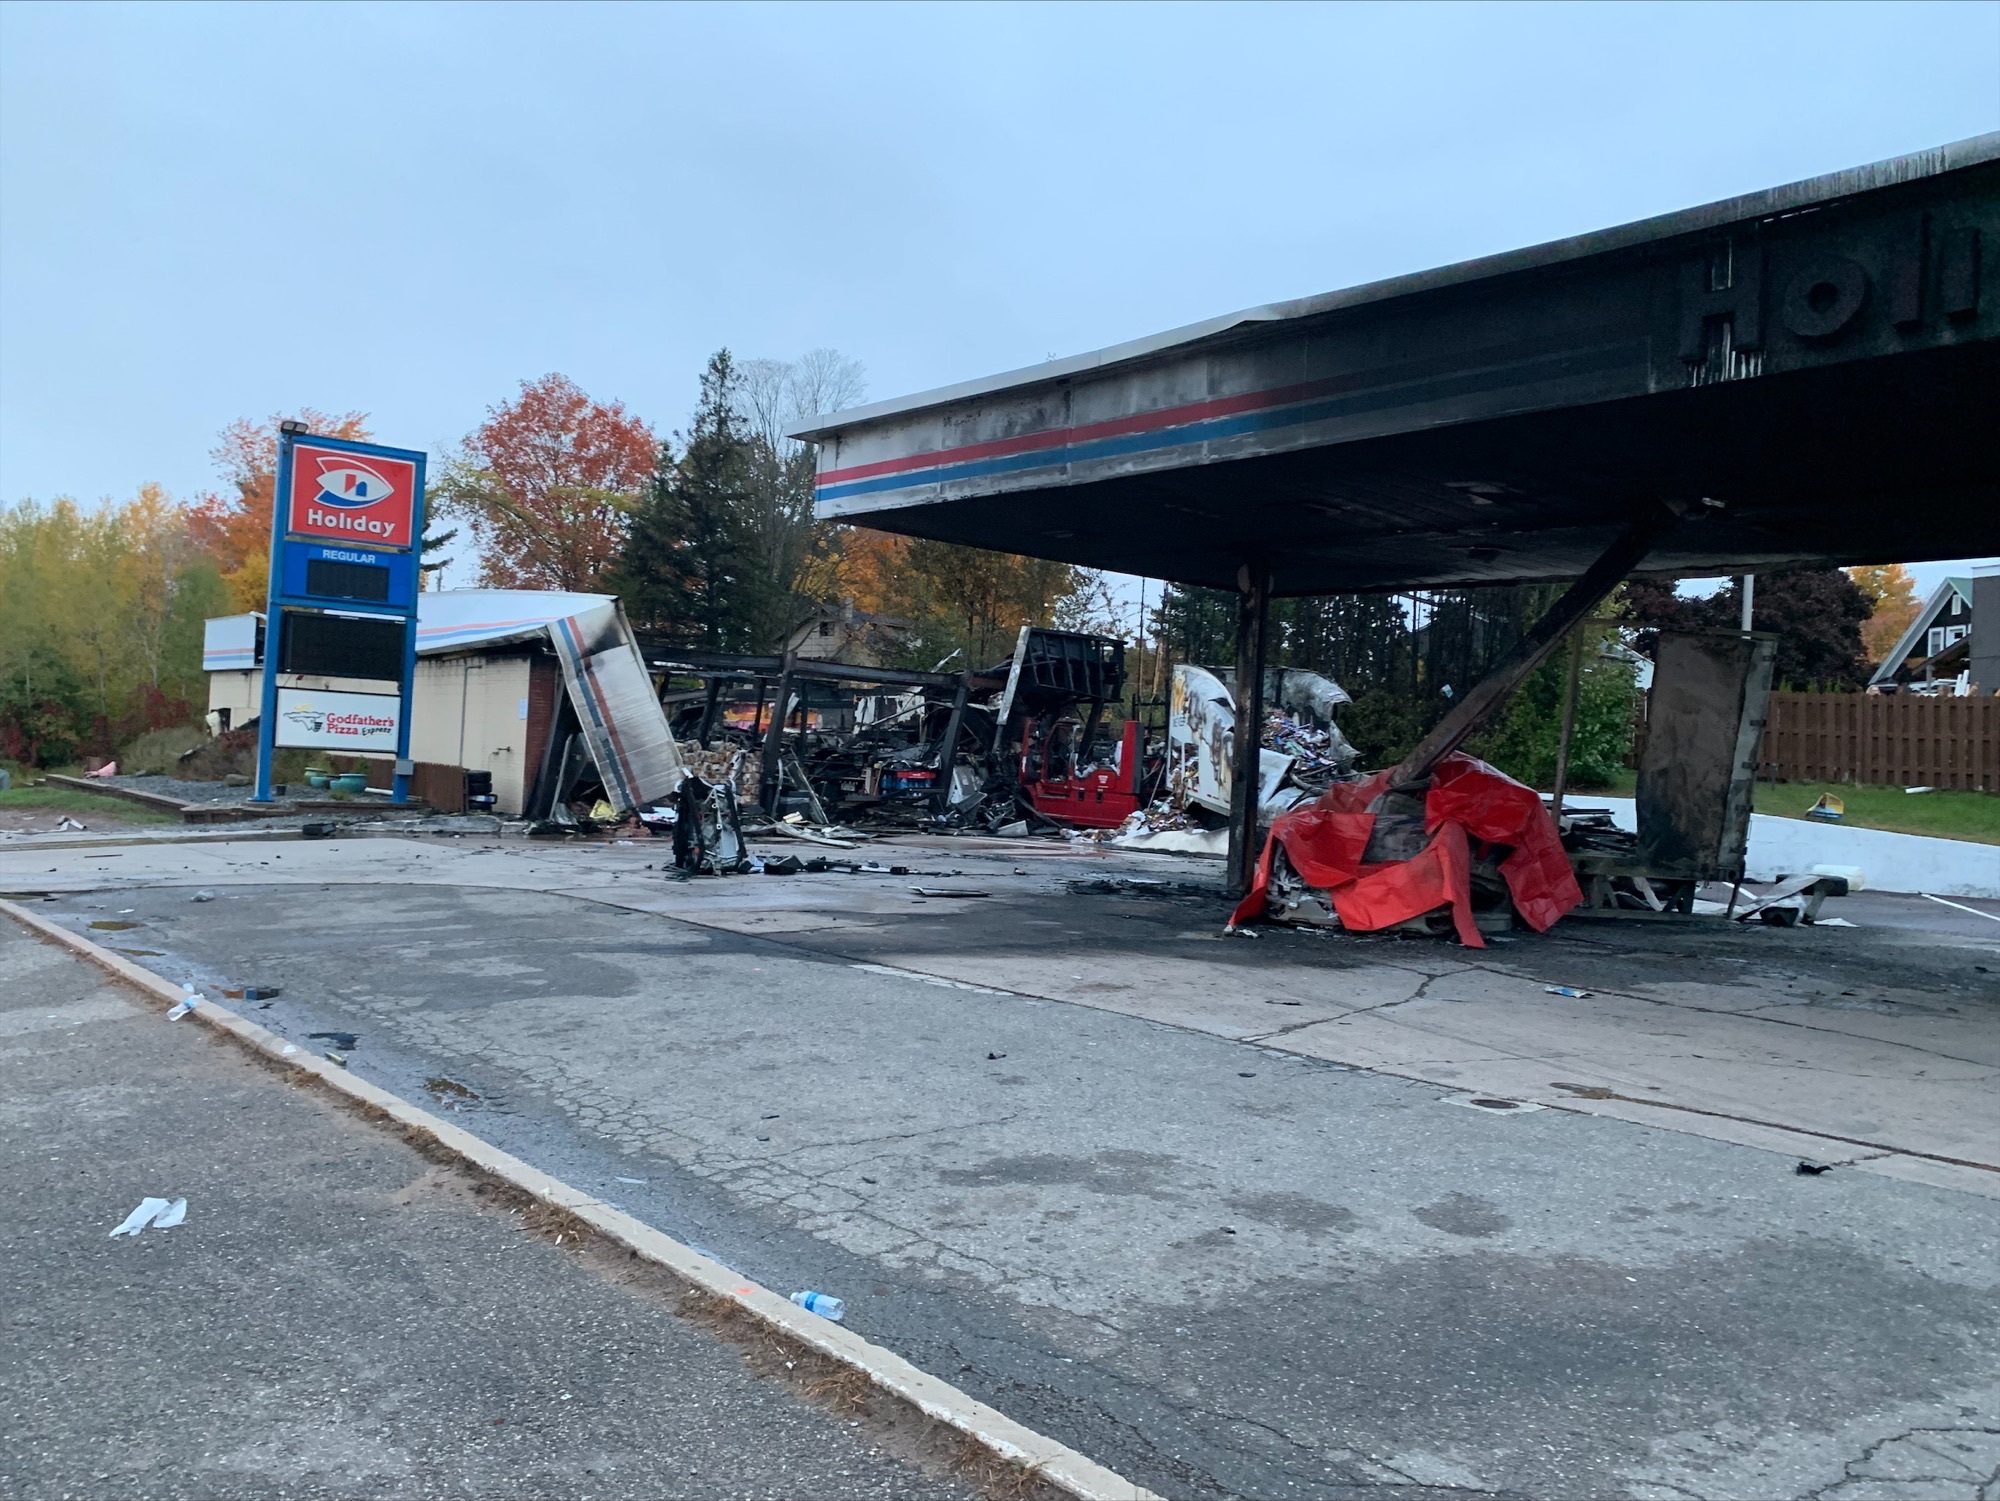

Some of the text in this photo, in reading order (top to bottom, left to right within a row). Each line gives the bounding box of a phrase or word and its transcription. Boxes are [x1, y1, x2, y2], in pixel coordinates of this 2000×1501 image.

[307, 508, 396, 538] Holiday
[322, 549, 376, 564] REGULAR
[326, 712, 395, 727] Godfather's
[326, 723, 392, 737] Pizza Express
